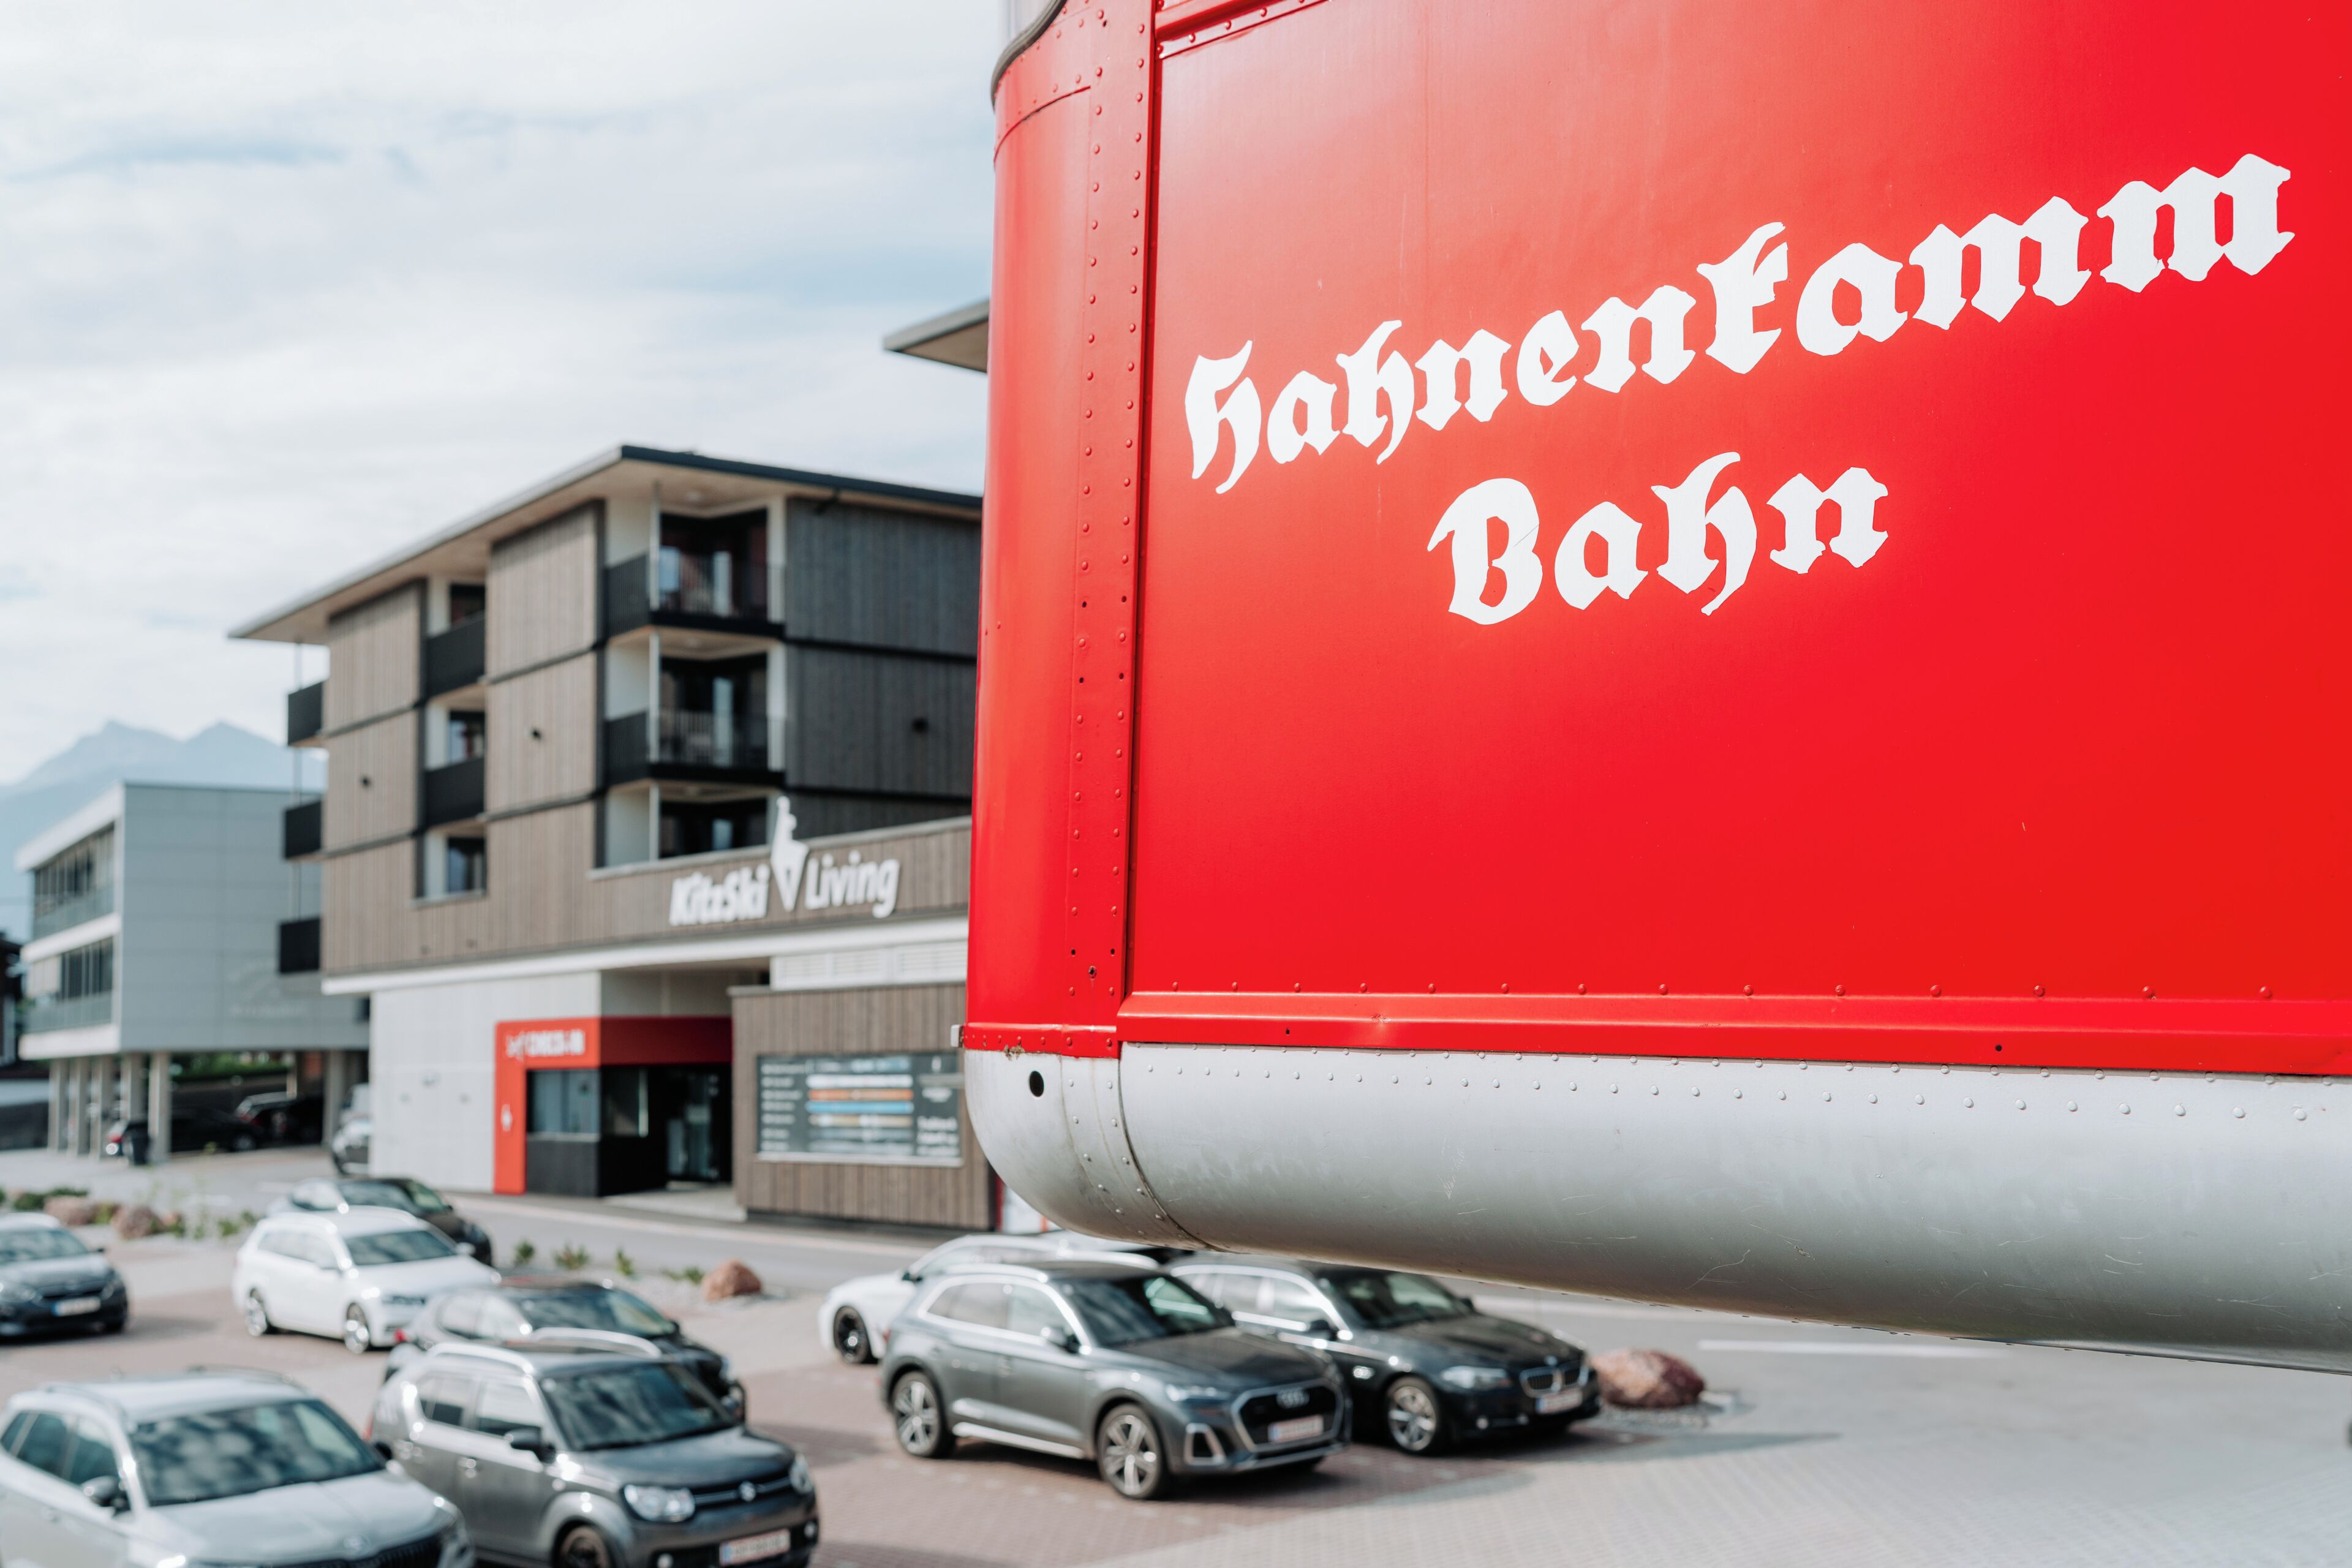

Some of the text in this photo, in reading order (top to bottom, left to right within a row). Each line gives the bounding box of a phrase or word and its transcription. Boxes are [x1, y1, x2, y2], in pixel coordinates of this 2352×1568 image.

[1184, 154, 2295, 494] Hahnenkamm
[1427, 451, 1888, 625] Bahn
[804, 850, 900, 918] Living
